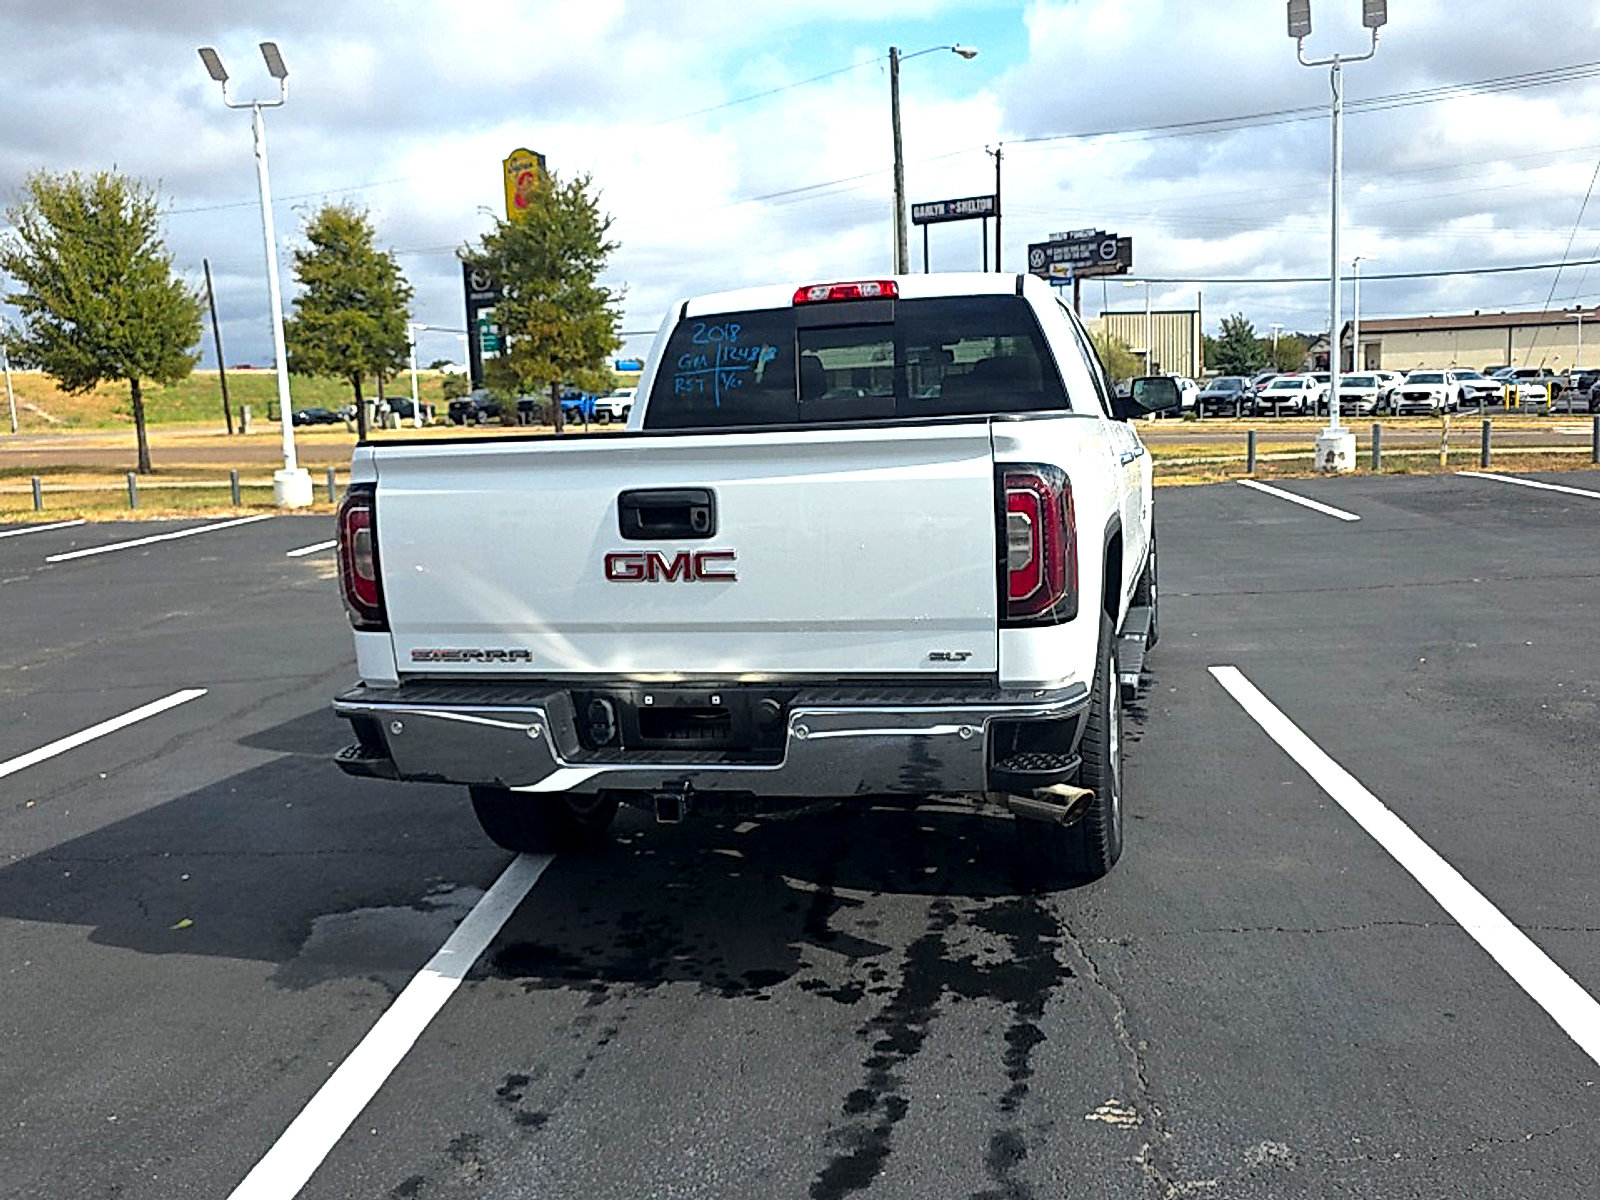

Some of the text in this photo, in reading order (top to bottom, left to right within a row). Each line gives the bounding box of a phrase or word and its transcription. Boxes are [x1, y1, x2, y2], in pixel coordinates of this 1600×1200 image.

[693, 323, 741, 344] 2018
[603, 549, 738, 583] GMC
[411, 648, 533, 663] SIERRA
[928, 650, 973, 662] SLT
